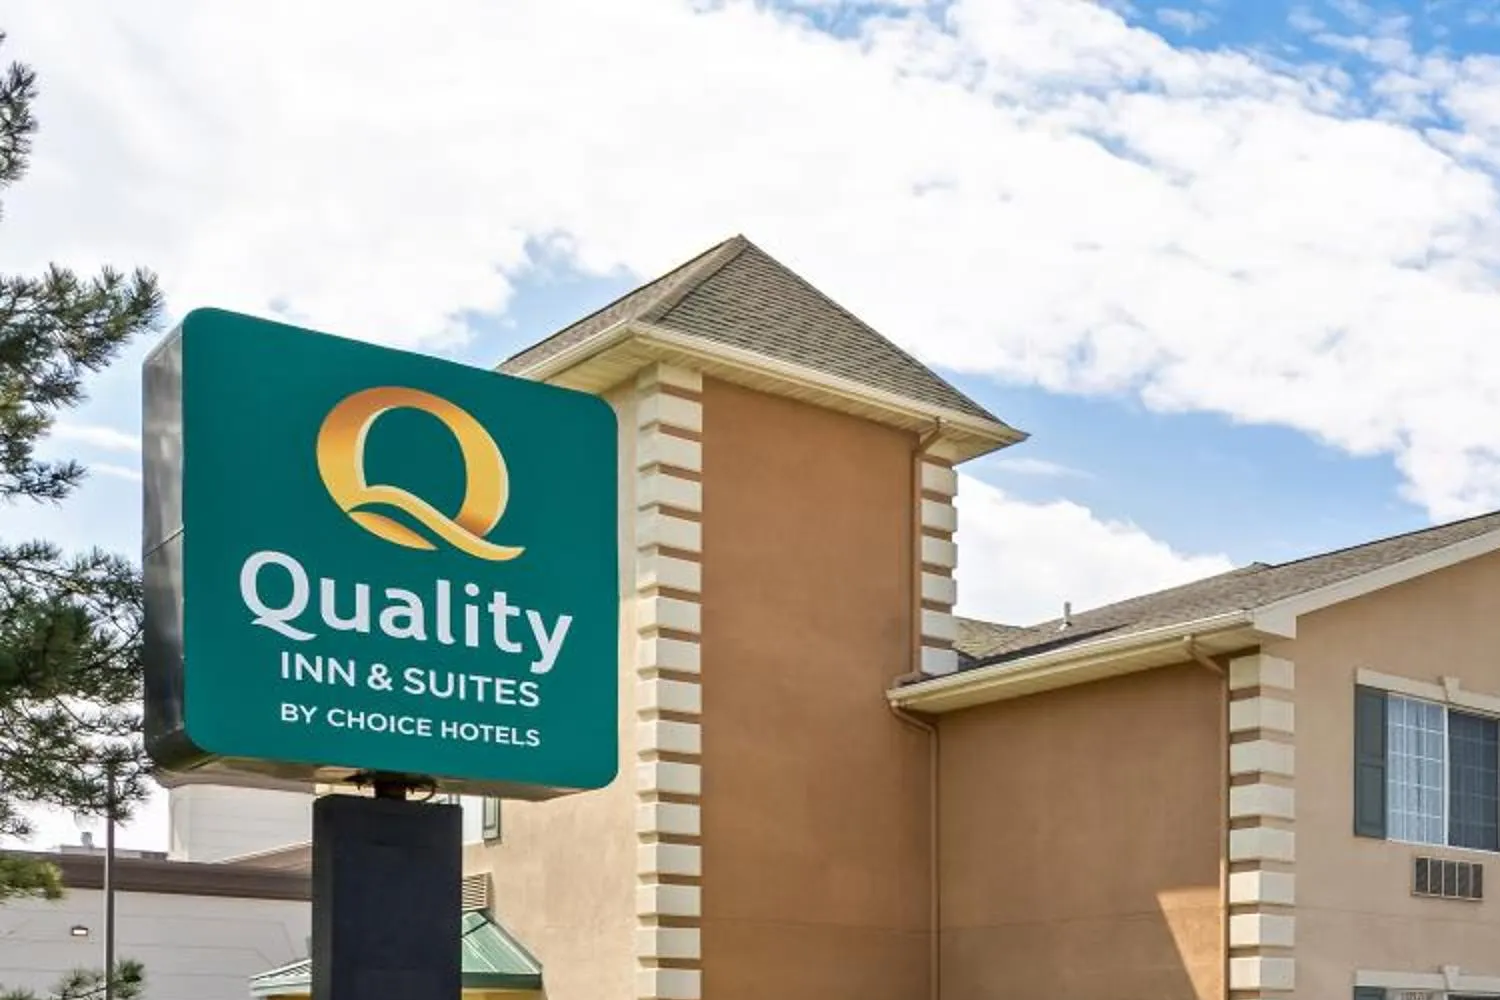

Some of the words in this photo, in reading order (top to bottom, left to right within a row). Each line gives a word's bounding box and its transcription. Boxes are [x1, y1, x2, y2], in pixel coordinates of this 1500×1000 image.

[316, 386, 526, 562] Q
[239, 550, 573, 675] Quality
[281, 651, 356, 687] INN
[367, 663, 393, 692] &
[403, 667, 541, 707] SUITES
[281, 703, 318, 724] BY
[326, 708, 433, 737] CHOICE
[441, 720, 541, 747] HOTELS
